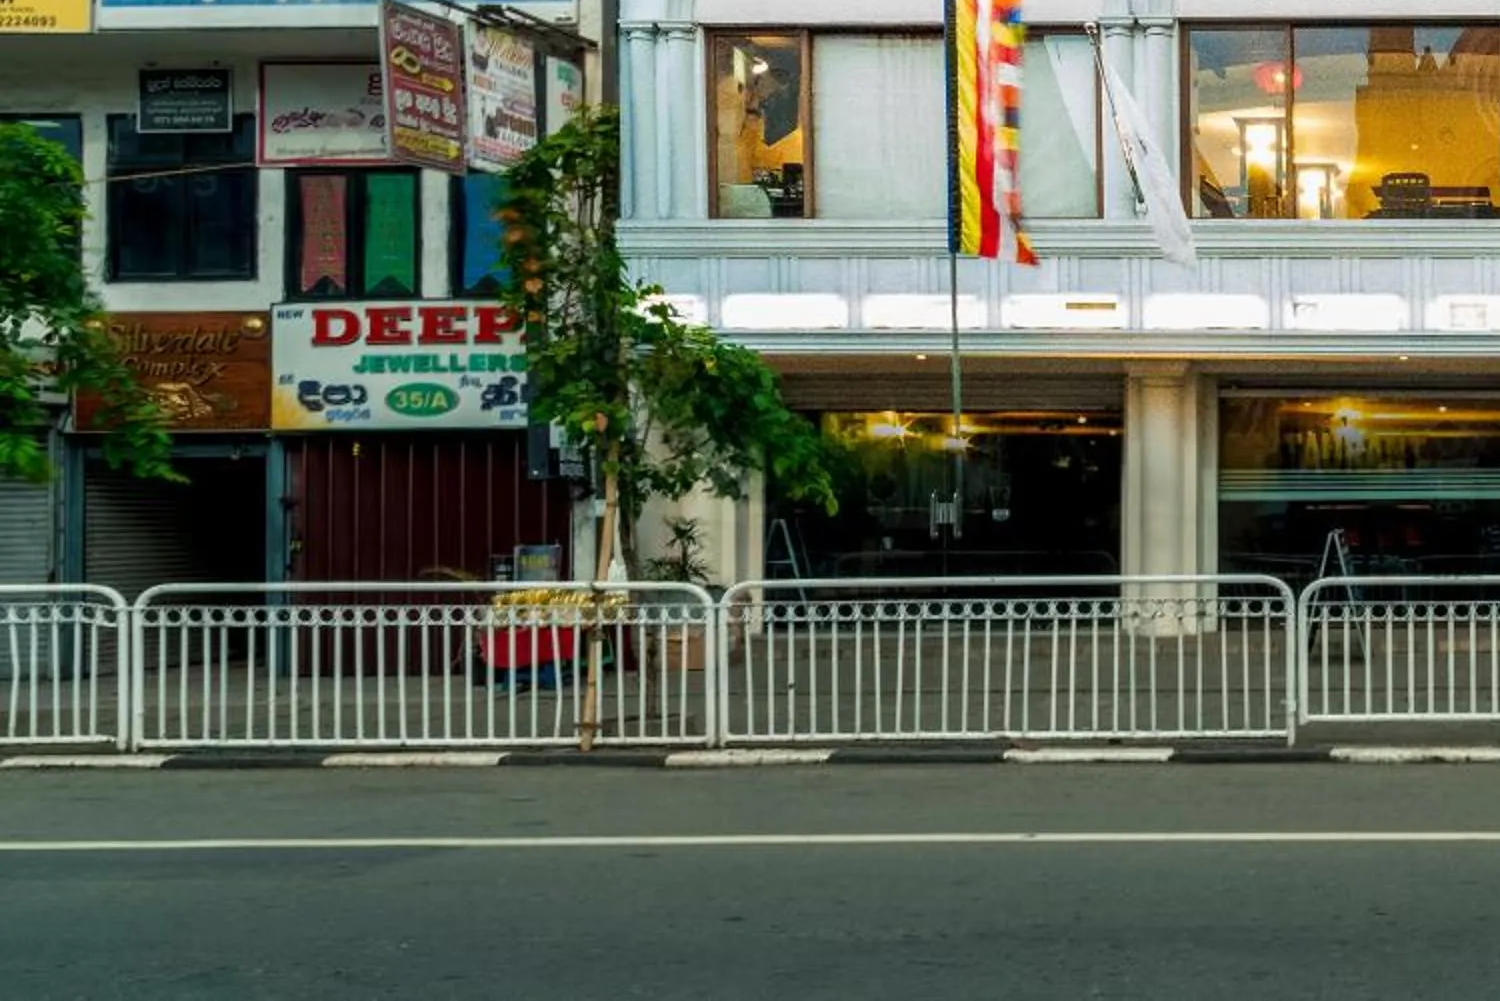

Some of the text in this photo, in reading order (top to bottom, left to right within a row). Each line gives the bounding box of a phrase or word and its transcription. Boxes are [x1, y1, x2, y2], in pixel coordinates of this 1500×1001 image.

[109, 323, 242, 354] Silverdale
[276, 306, 528, 346] NEW DEEP
[121, 355, 226, 386] Complex
[352, 353, 528, 374] JEWELLERS
[395, 390, 449, 409] 35/A
